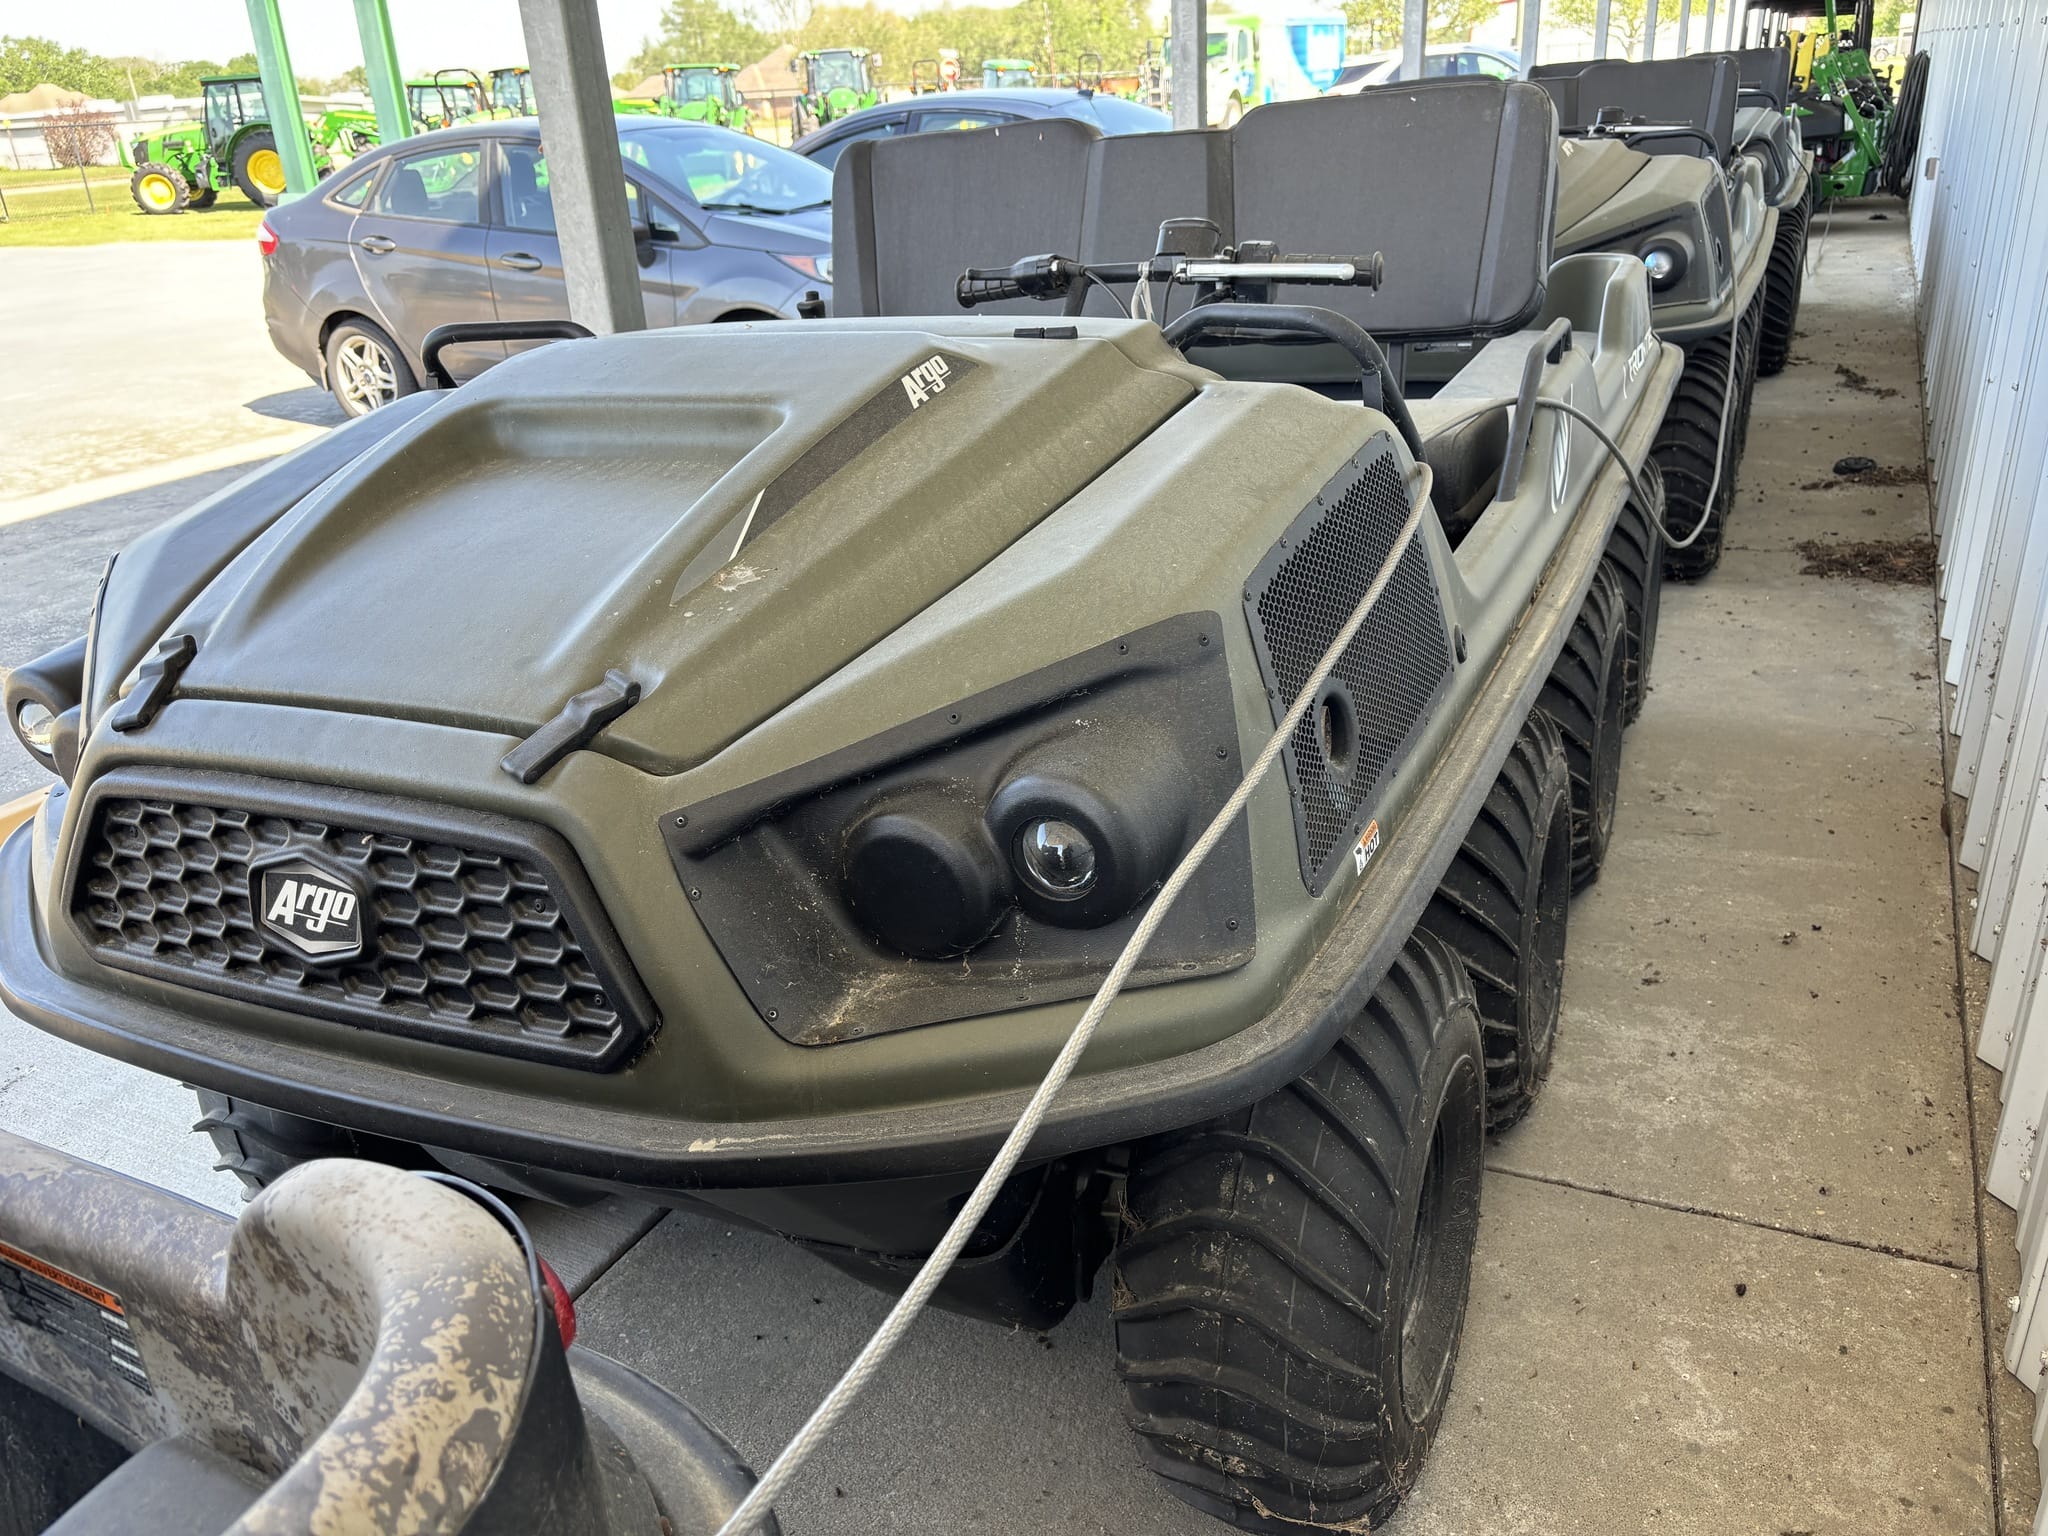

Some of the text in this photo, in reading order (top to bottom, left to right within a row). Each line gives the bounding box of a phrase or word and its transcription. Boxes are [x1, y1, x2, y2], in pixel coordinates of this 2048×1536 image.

[901, 354, 951, 409] Argo
[1364, 831, 1378, 861] HOT
[267, 879, 356, 933] Argo
